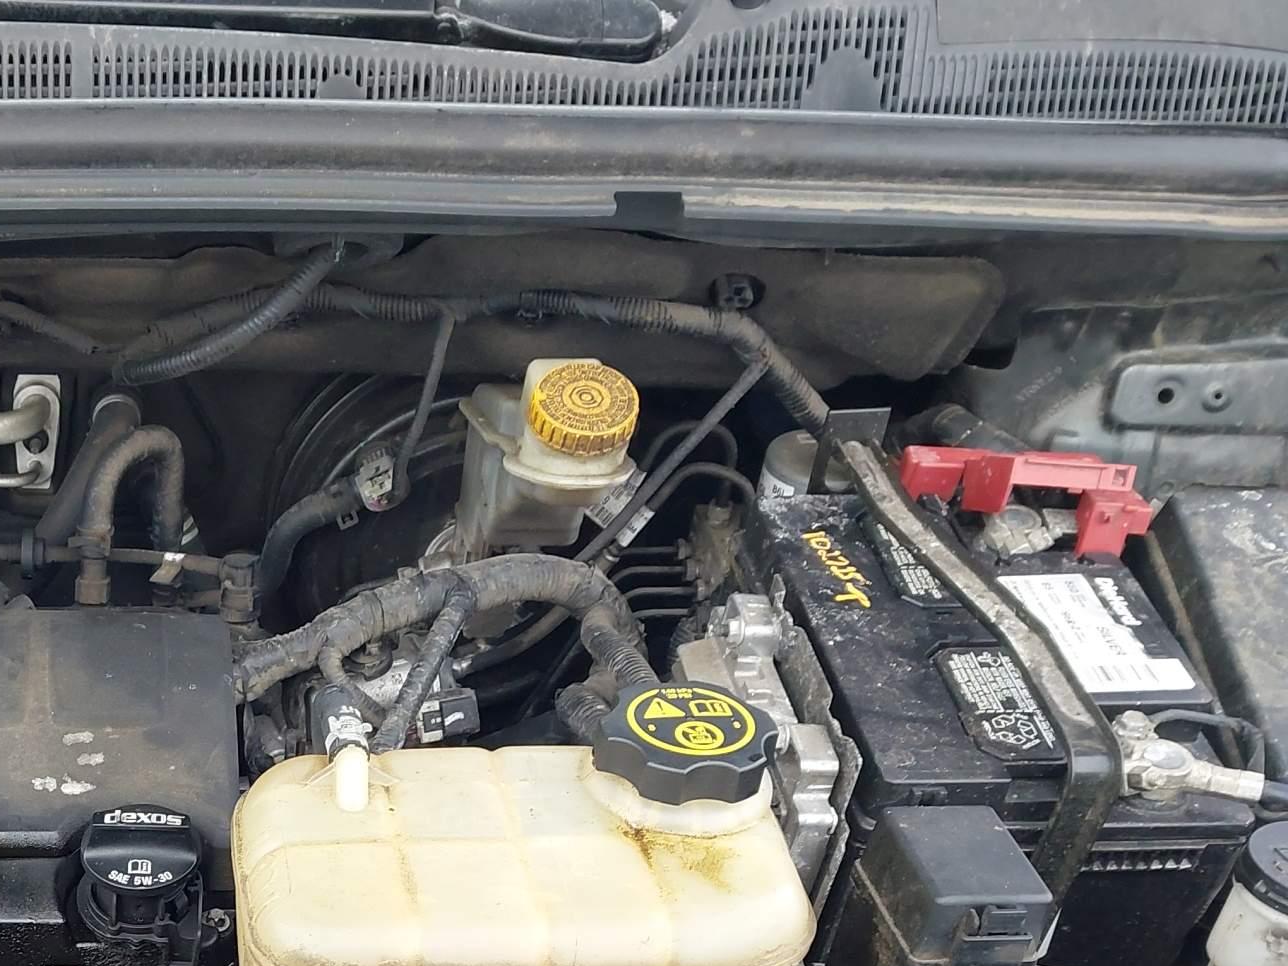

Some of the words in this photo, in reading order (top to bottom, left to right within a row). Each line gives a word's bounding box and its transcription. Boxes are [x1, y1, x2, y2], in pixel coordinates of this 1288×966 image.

[104, 809, 186, 826] dexos
[108, 870, 131, 885] SAE
[133, 871, 173, 886] 5W-30
